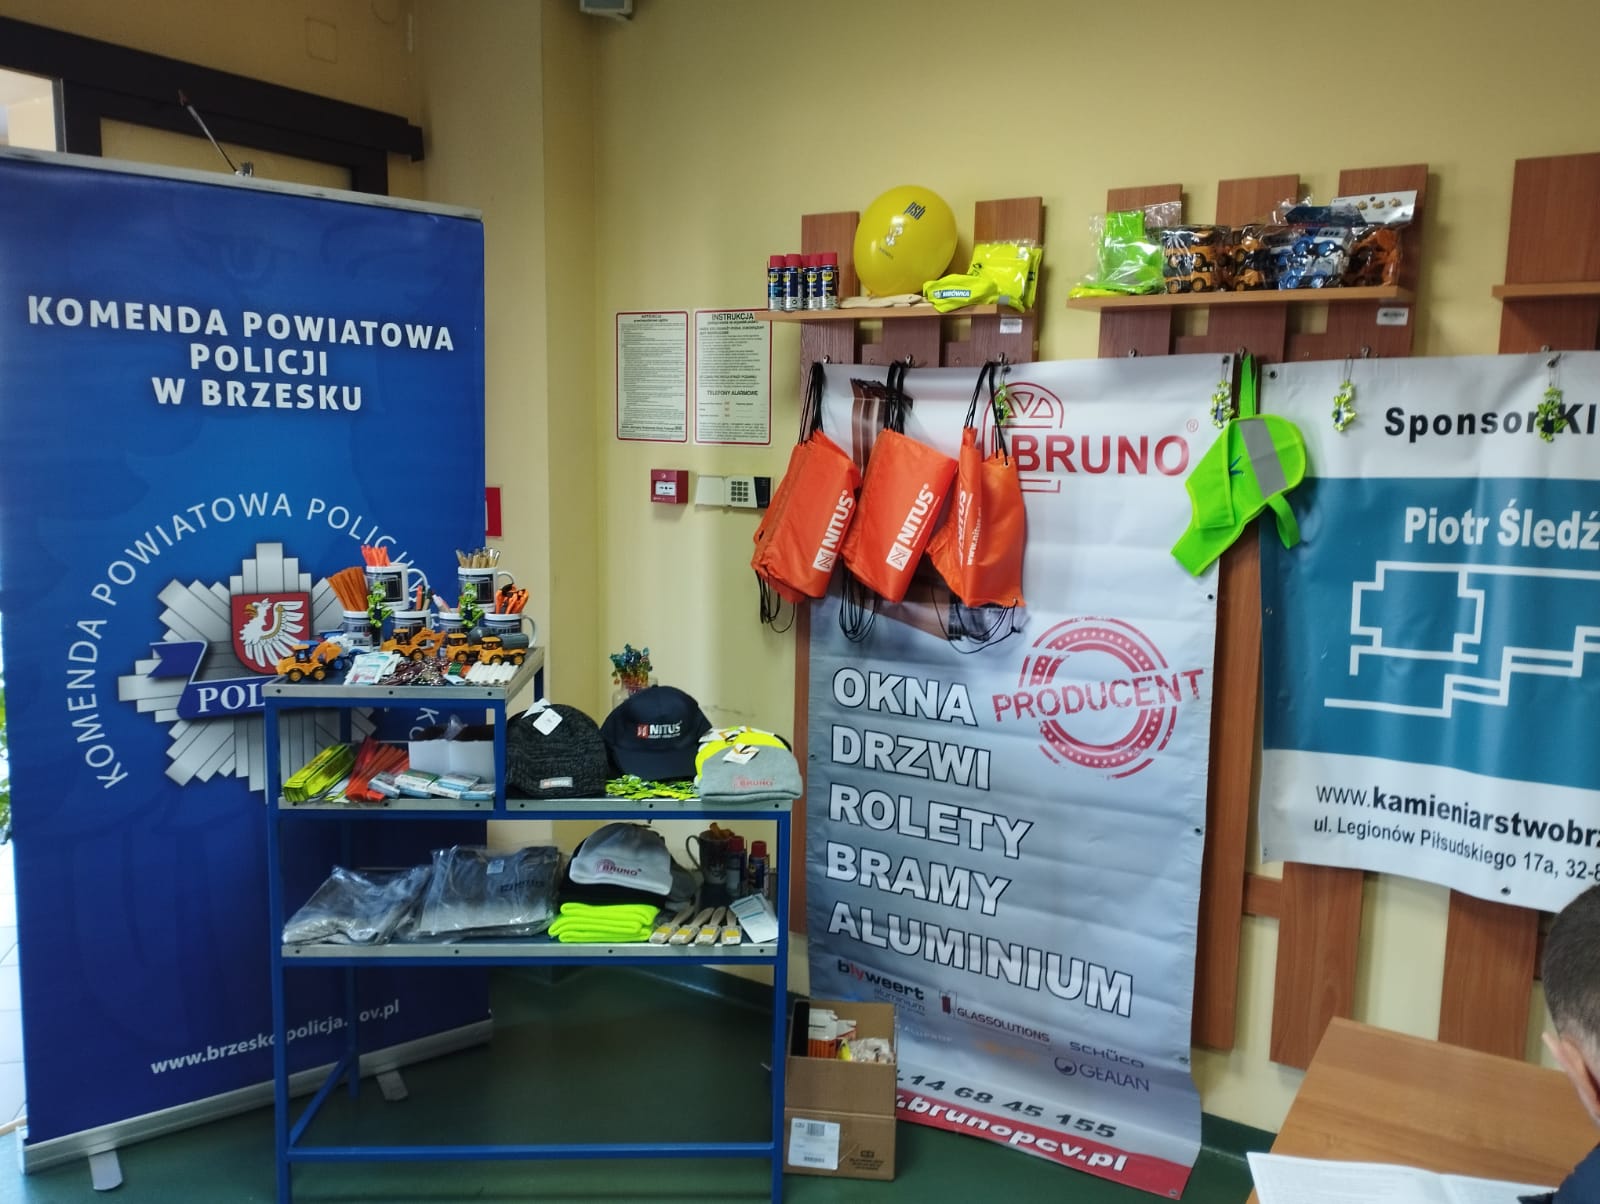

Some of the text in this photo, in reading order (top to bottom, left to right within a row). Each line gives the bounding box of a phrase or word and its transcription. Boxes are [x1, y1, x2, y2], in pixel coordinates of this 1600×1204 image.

[28, 295, 454, 351] KOMENDA POWIATOWA
[712, 312, 754, 321] INSTRUKCJA
[190, 343, 328, 377] POLICJI
[151, 377, 363, 411] W BRZESKU
[1385, 406, 1538, 443] Sponsor
[1011, 434, 1190, 476] BRUNO
[821, 495, 854, 549] NITUS
[897, 488, 934, 545] NITUS
[1404, 497, 1600, 551] Piotr Śledź
[91, 492, 292, 606] POWIATOWA
[67, 617, 128, 789] KOMENDA
[832, 667, 978, 727] OKNA
[992, 668, 1204, 722] PRODUCENT
[650, 722, 680, 735] NITUS
[831, 724, 991, 791] DRZWI
[829, 782, 1034, 859] ROLETY
[1314, 816, 1332, 833] ul.
[1337, 817, 1415, 845] Legionów
[1420, 829, 1517, 870] Piłsudskiego
[1523, 852, 1559, 879] 17a,
[826, 840, 1012, 916] BRAMY
[827, 901, 1133, 1018] ALUMINIUM
[837, 959, 924, 1000] blyweert
[956, 1007, 1050, 1042] GLASSOLUTIONS
[1079, 1064, 1150, 1092] GEALAN
[910, 1075, 945, 1091] 14
[955, 1087, 993, 1103] 68
[1002, 1101, 1044, 1117] 45
[1056, 1113, 1118, 1138] 155
